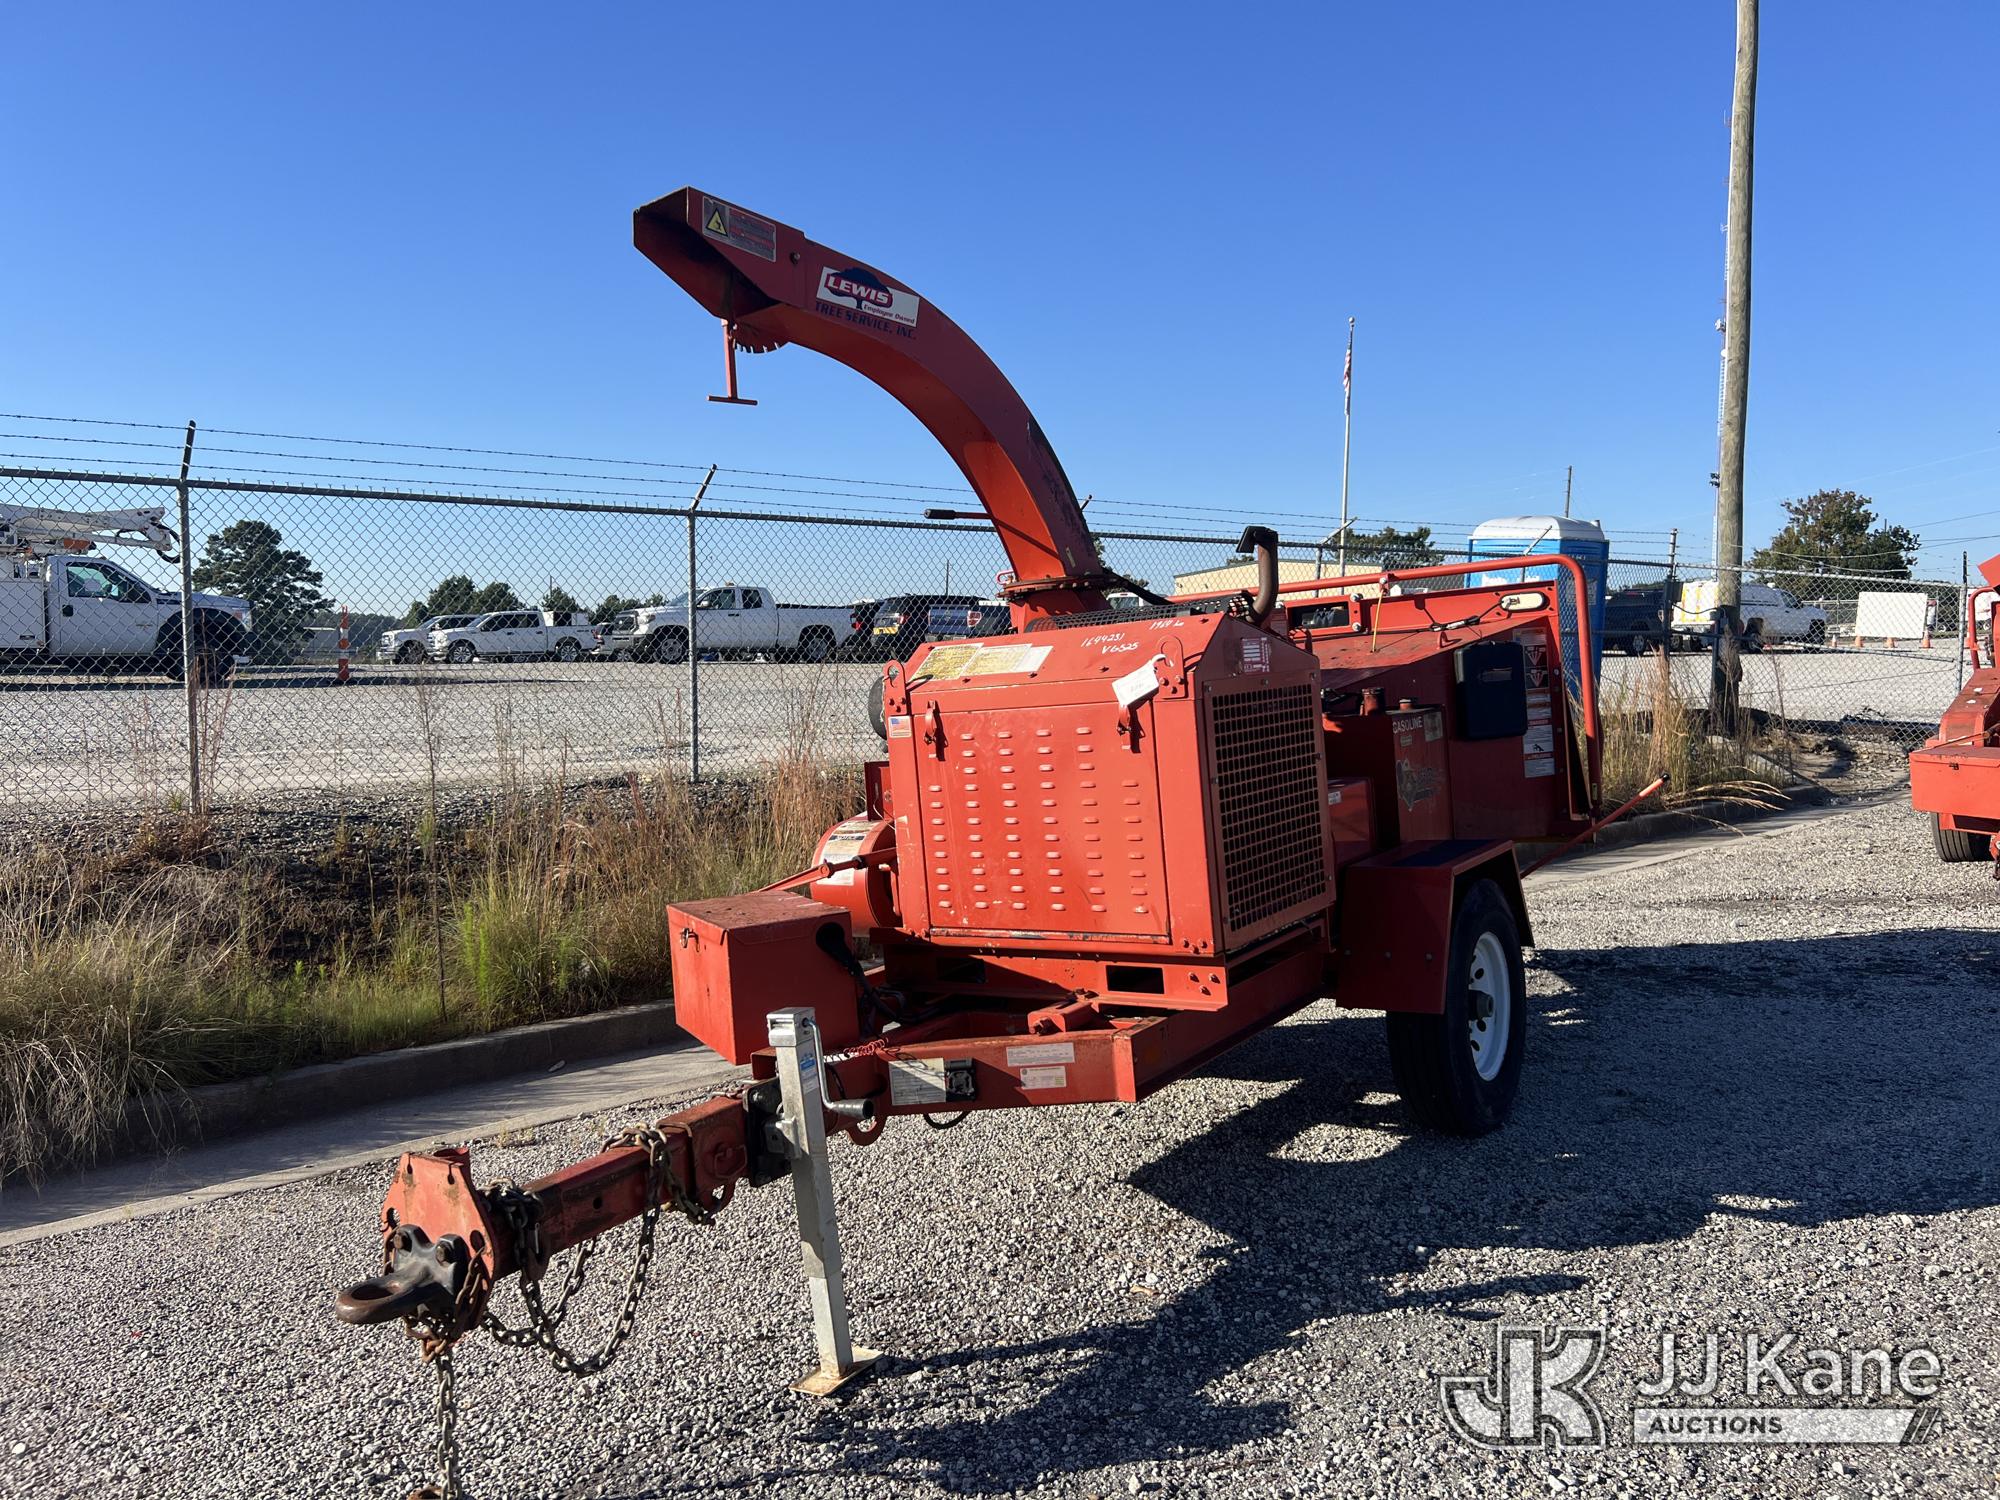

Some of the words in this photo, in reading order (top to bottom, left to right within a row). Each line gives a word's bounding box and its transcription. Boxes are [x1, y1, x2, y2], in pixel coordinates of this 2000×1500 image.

[827, 275, 889, 304] LEWIS
[815, 302, 842, 319] TREE
[896, 325, 917, 340] INC.
[1392, 716, 1423, 734] GASOLINE
